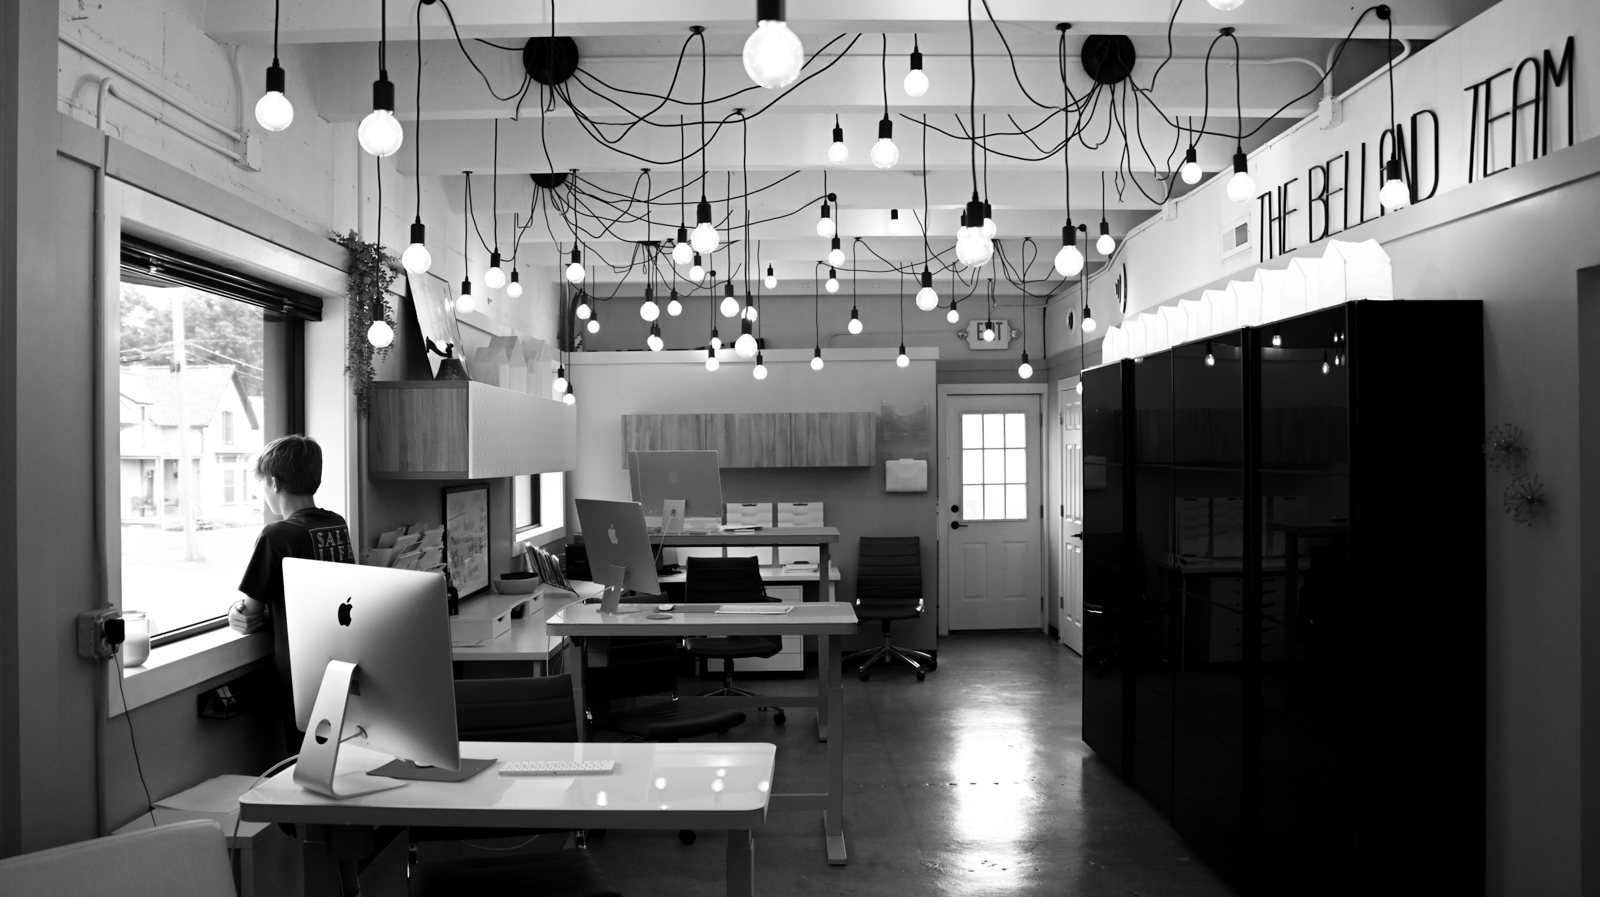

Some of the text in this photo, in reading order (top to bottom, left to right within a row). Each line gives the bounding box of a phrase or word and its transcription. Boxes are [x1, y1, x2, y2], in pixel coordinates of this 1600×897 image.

[1257, 36, 1575, 263] THE BELLAND TEAM
[976, 321, 1003, 341] EIT
